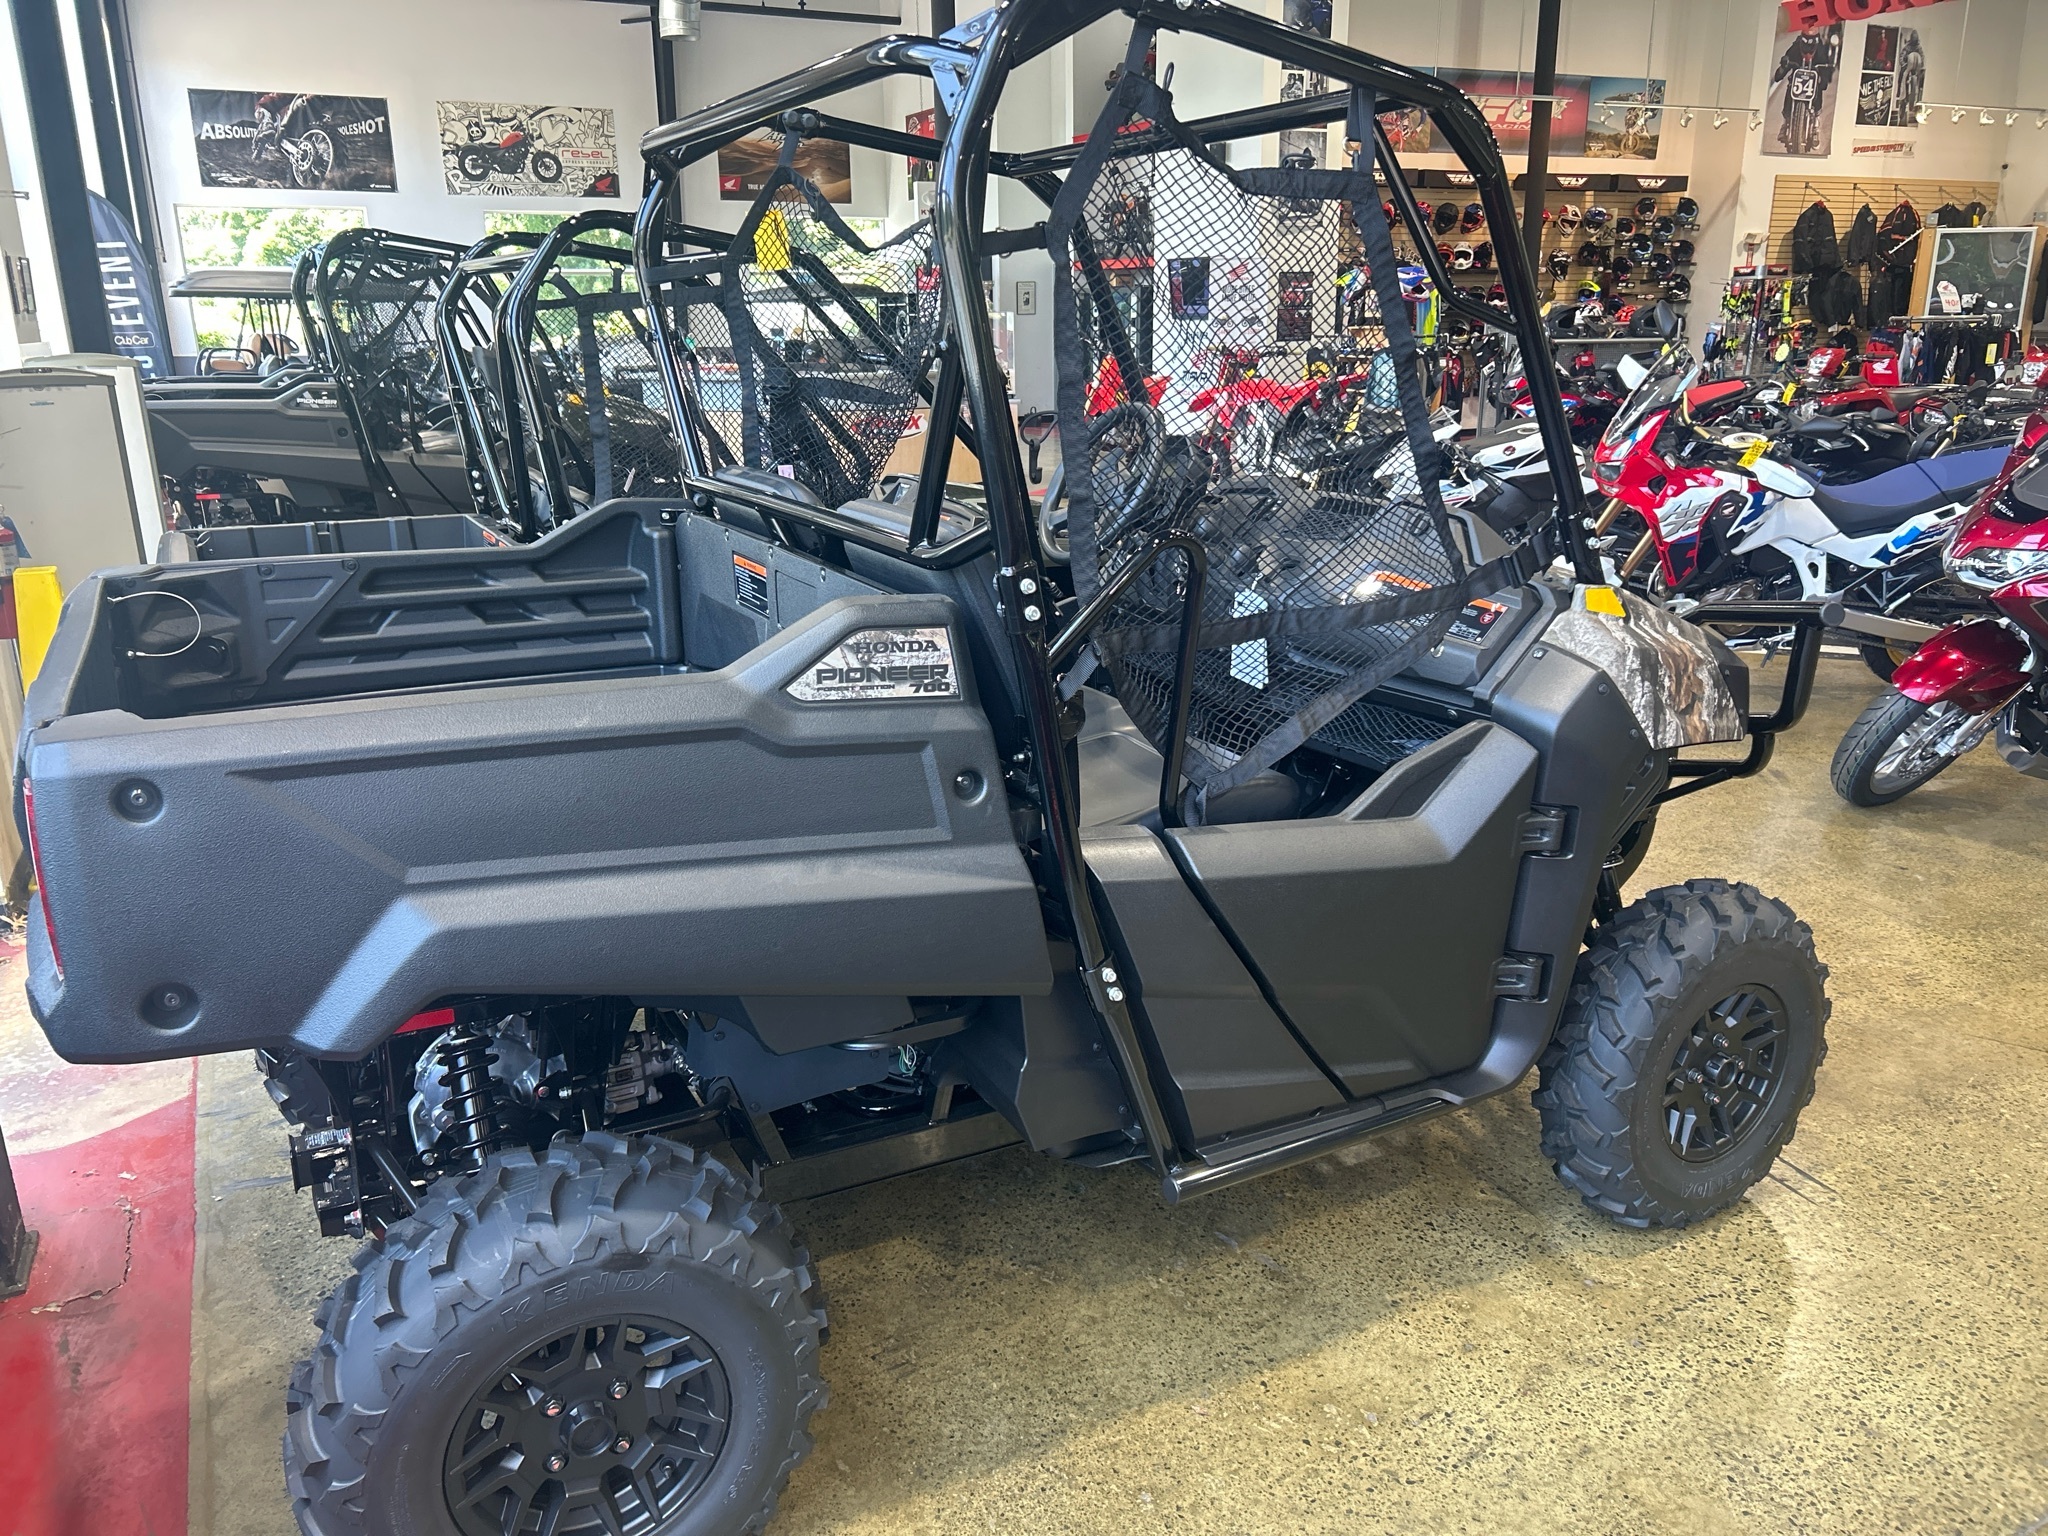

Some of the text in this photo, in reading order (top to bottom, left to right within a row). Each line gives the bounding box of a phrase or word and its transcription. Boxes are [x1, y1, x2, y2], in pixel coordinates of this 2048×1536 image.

[1793, 77, 1814, 96] 54
[1556, 176, 1588, 185] FLY
[855, 640, 941, 655] HONDA
[816, 664, 949, 685] PIONEER
[860, 683, 896, 691] EDITION
[909, 681, 951, 693] 700
[500, 1269, 675, 1334] KENDA
